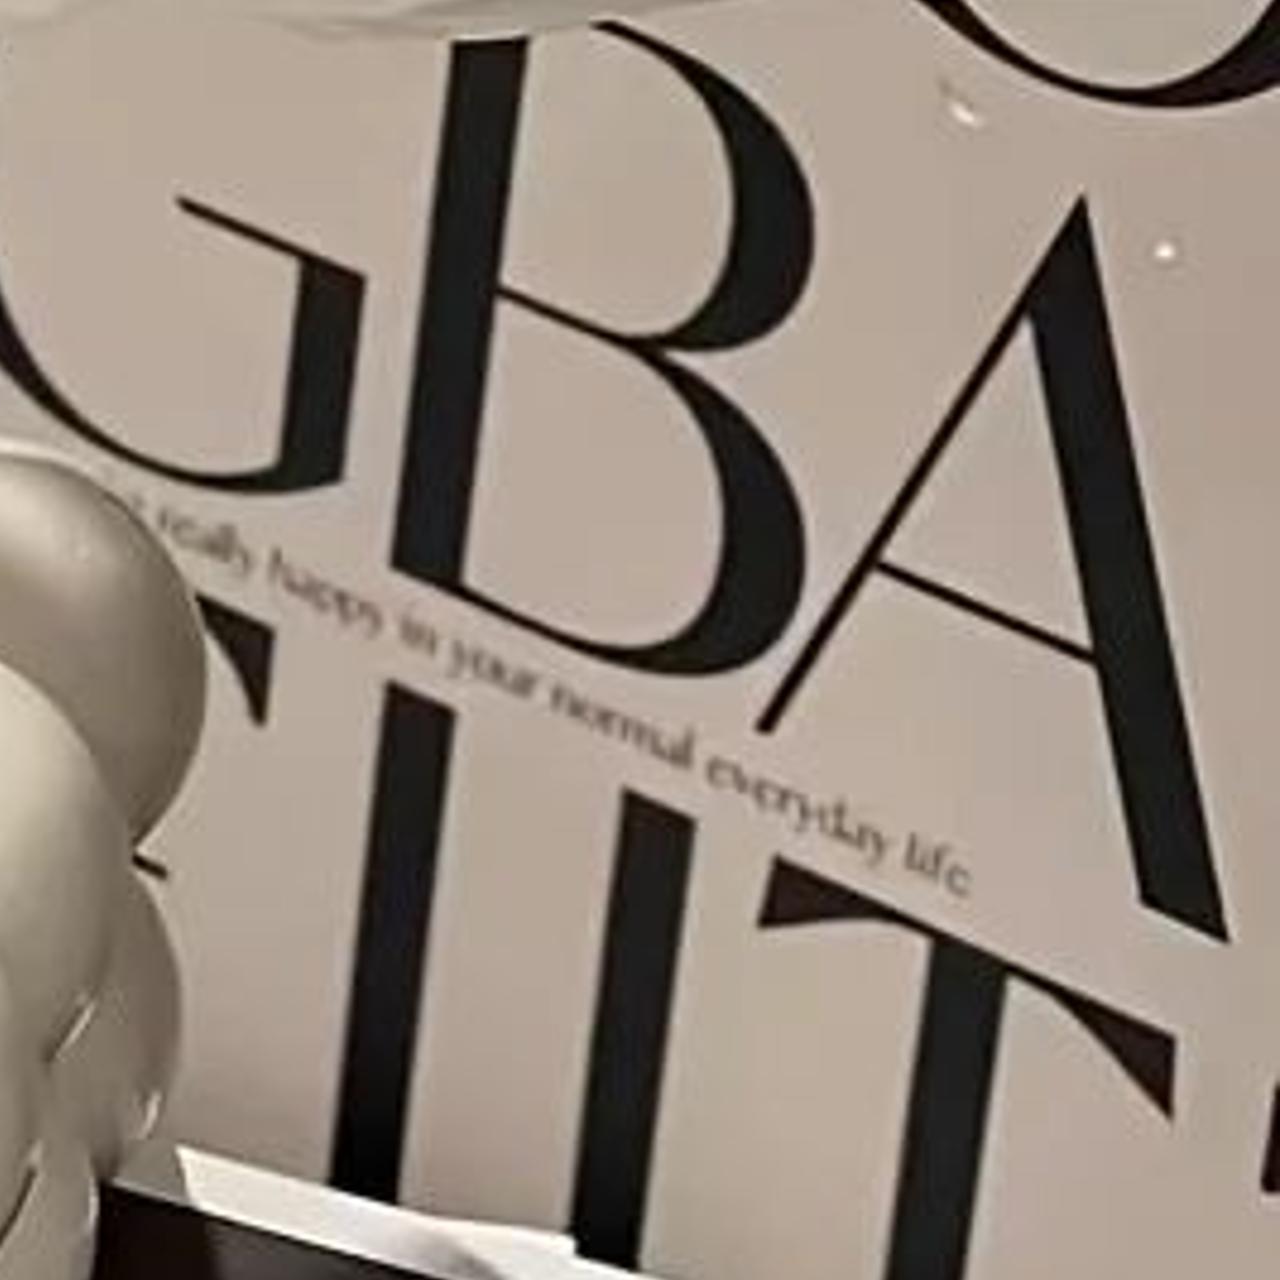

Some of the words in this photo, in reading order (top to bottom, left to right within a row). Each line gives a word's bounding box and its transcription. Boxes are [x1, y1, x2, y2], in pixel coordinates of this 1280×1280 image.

[267, 545, 384, 644] happy
[550, 685, 697, 772] normal
[704, 754, 892, 870] everyday
[902, 830, 974, 898] life
